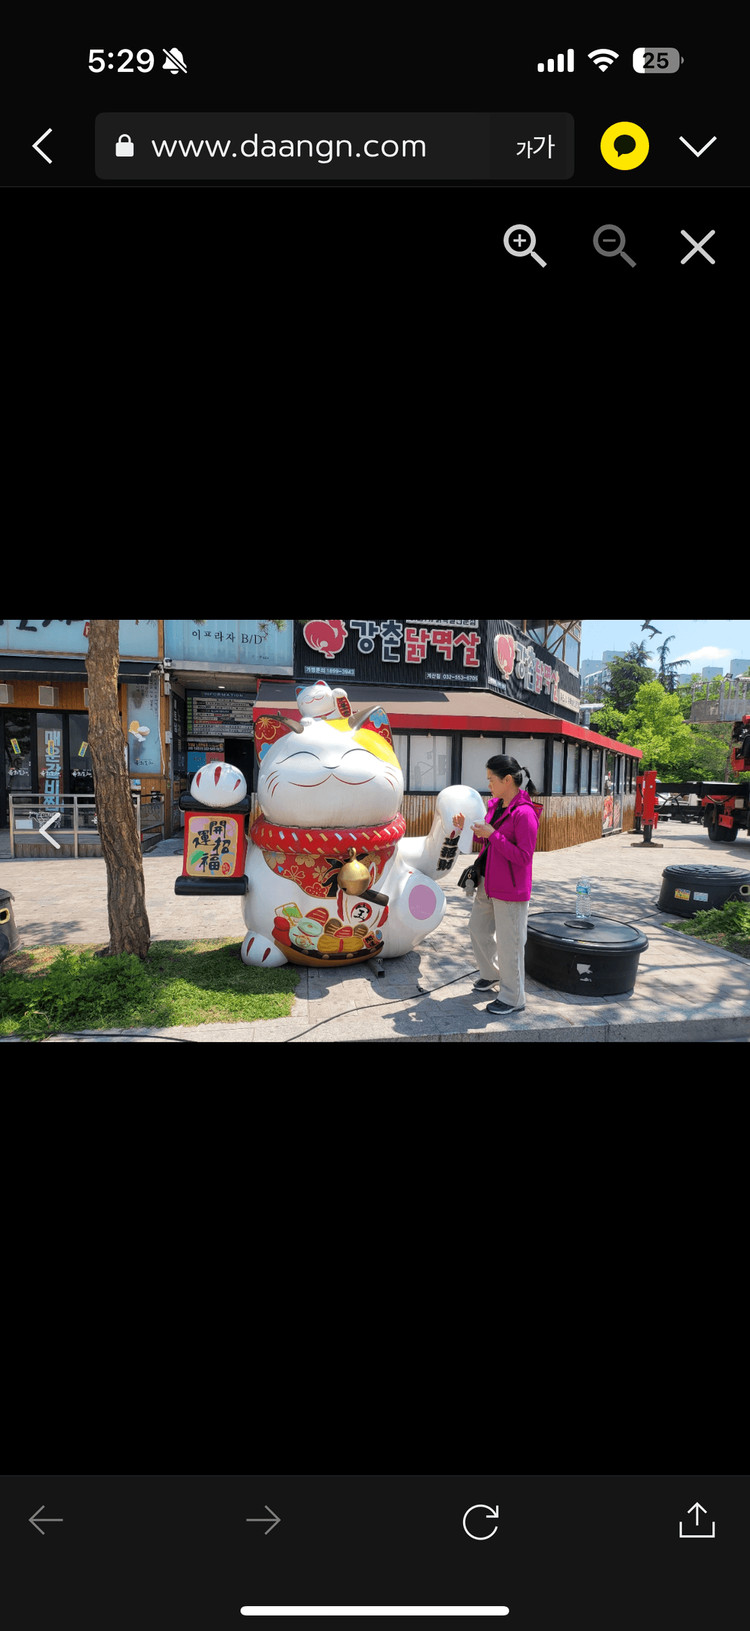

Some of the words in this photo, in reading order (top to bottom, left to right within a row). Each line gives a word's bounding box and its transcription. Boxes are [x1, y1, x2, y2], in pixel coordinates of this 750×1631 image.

[89, 49, 154, 73] 5:29
[643, 53, 668, 69] 25
[152, 133, 425, 164] www.daangn.com
[241, 633, 263, 645] B/D
